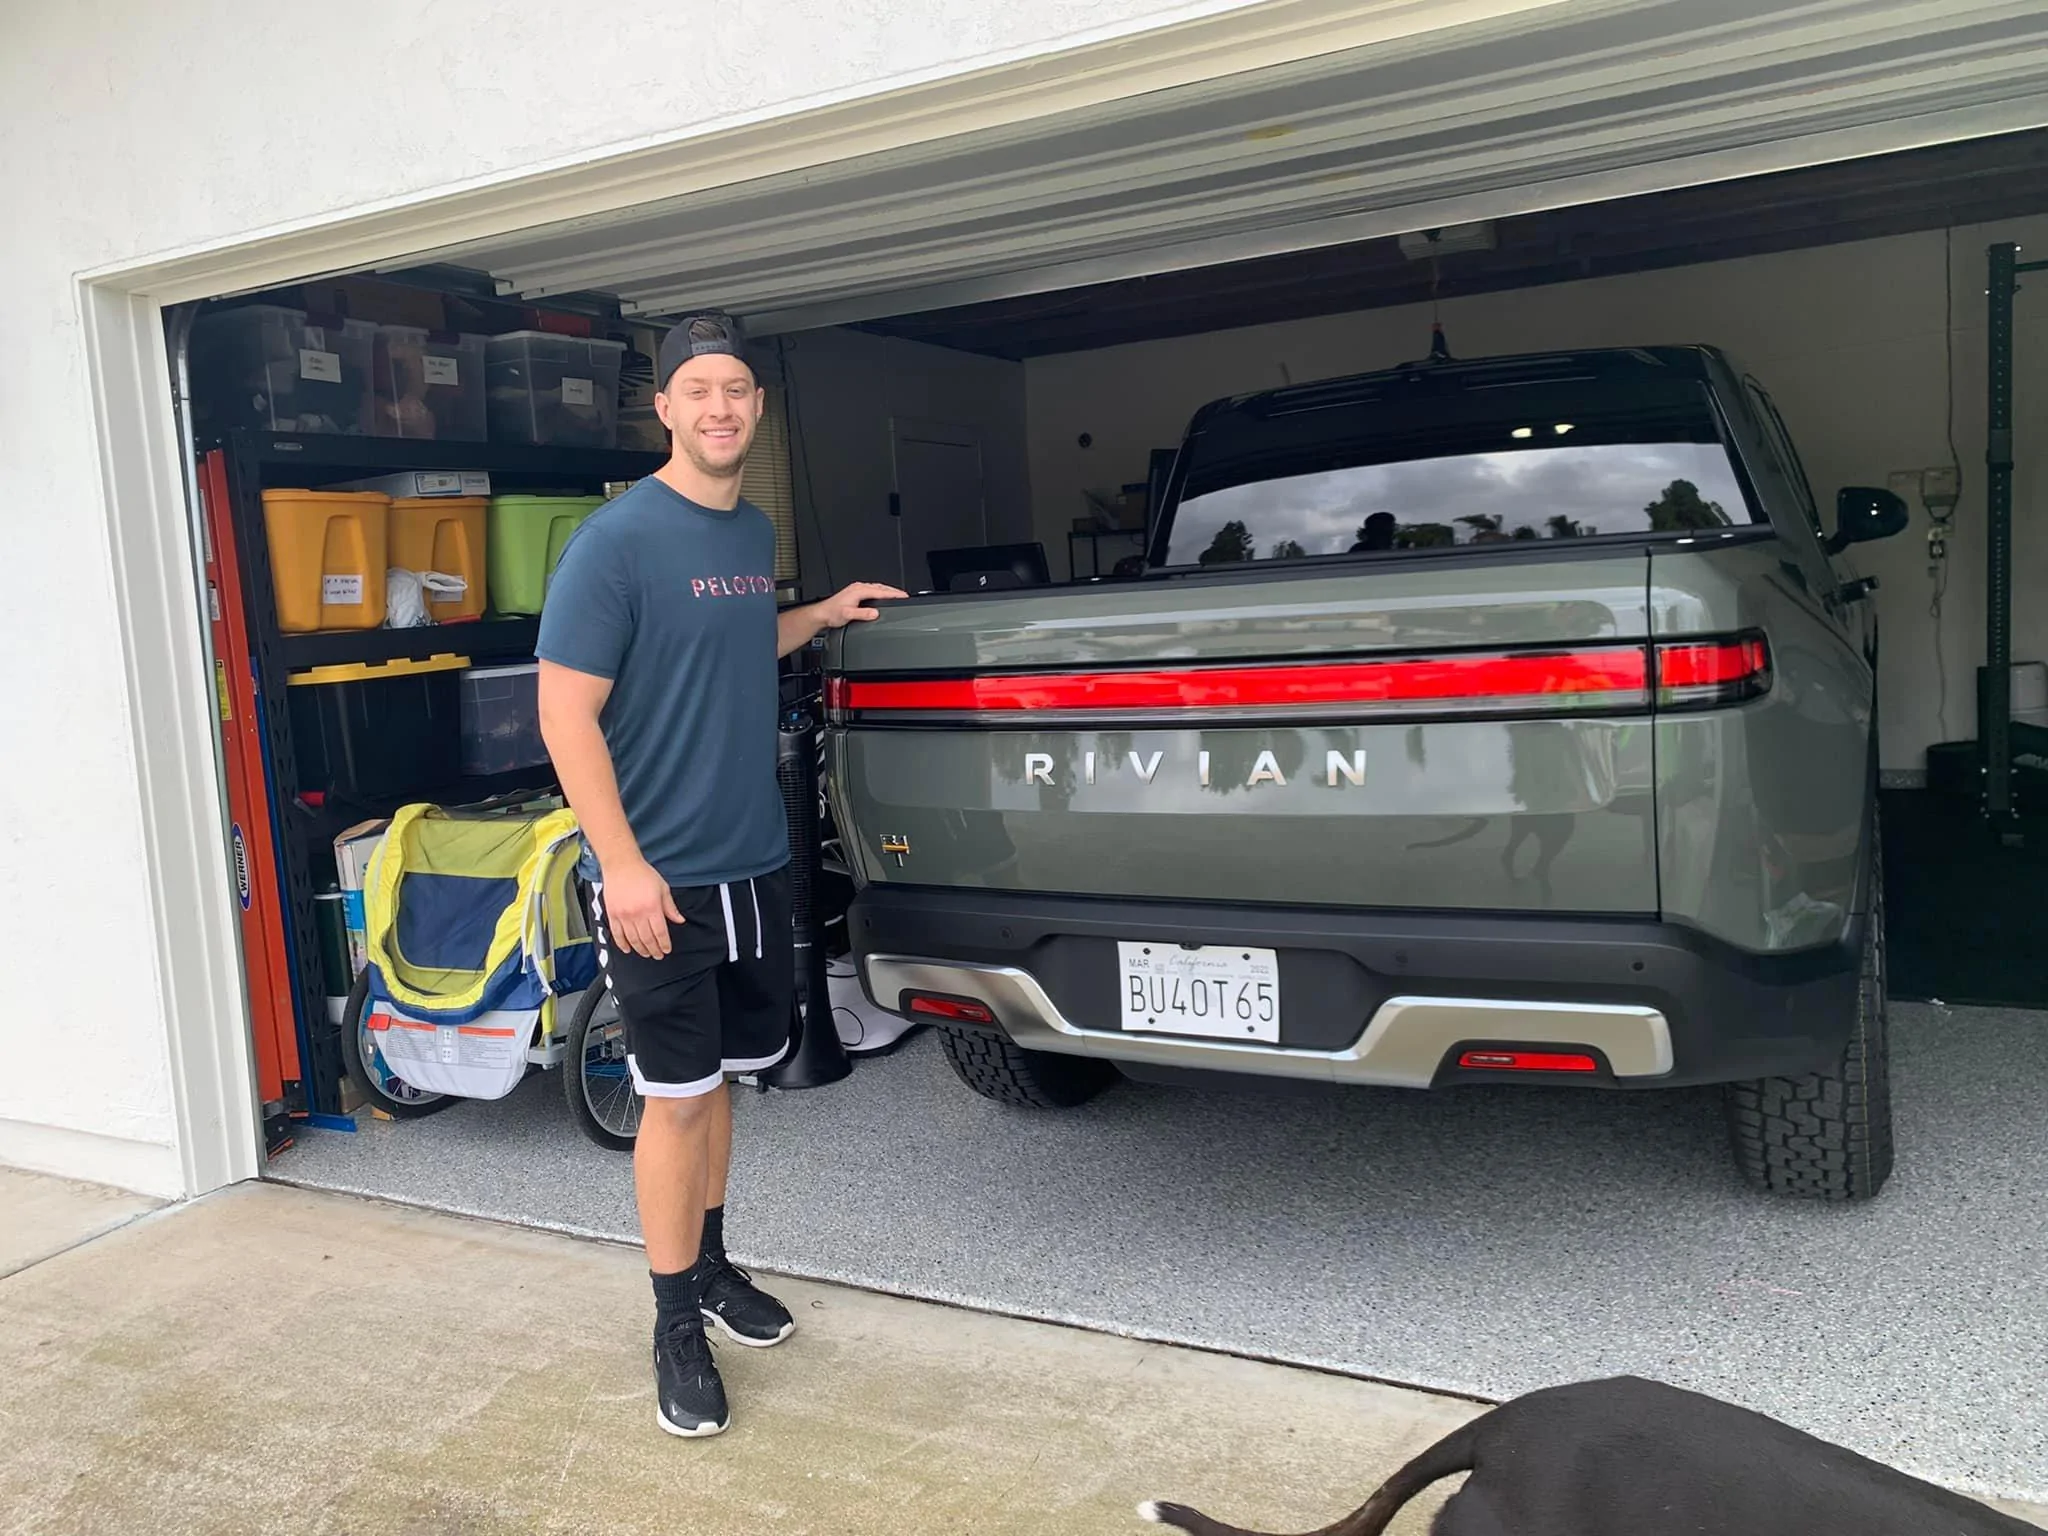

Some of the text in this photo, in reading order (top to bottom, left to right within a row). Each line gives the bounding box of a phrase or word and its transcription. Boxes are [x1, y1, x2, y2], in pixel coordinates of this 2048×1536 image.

[1024, 749, 1367, 787] RIVIAN
[234, 840, 248, 892] WERNER
[1128, 957, 1151, 969] MAR
[1169, 954, 1229, 972] California
